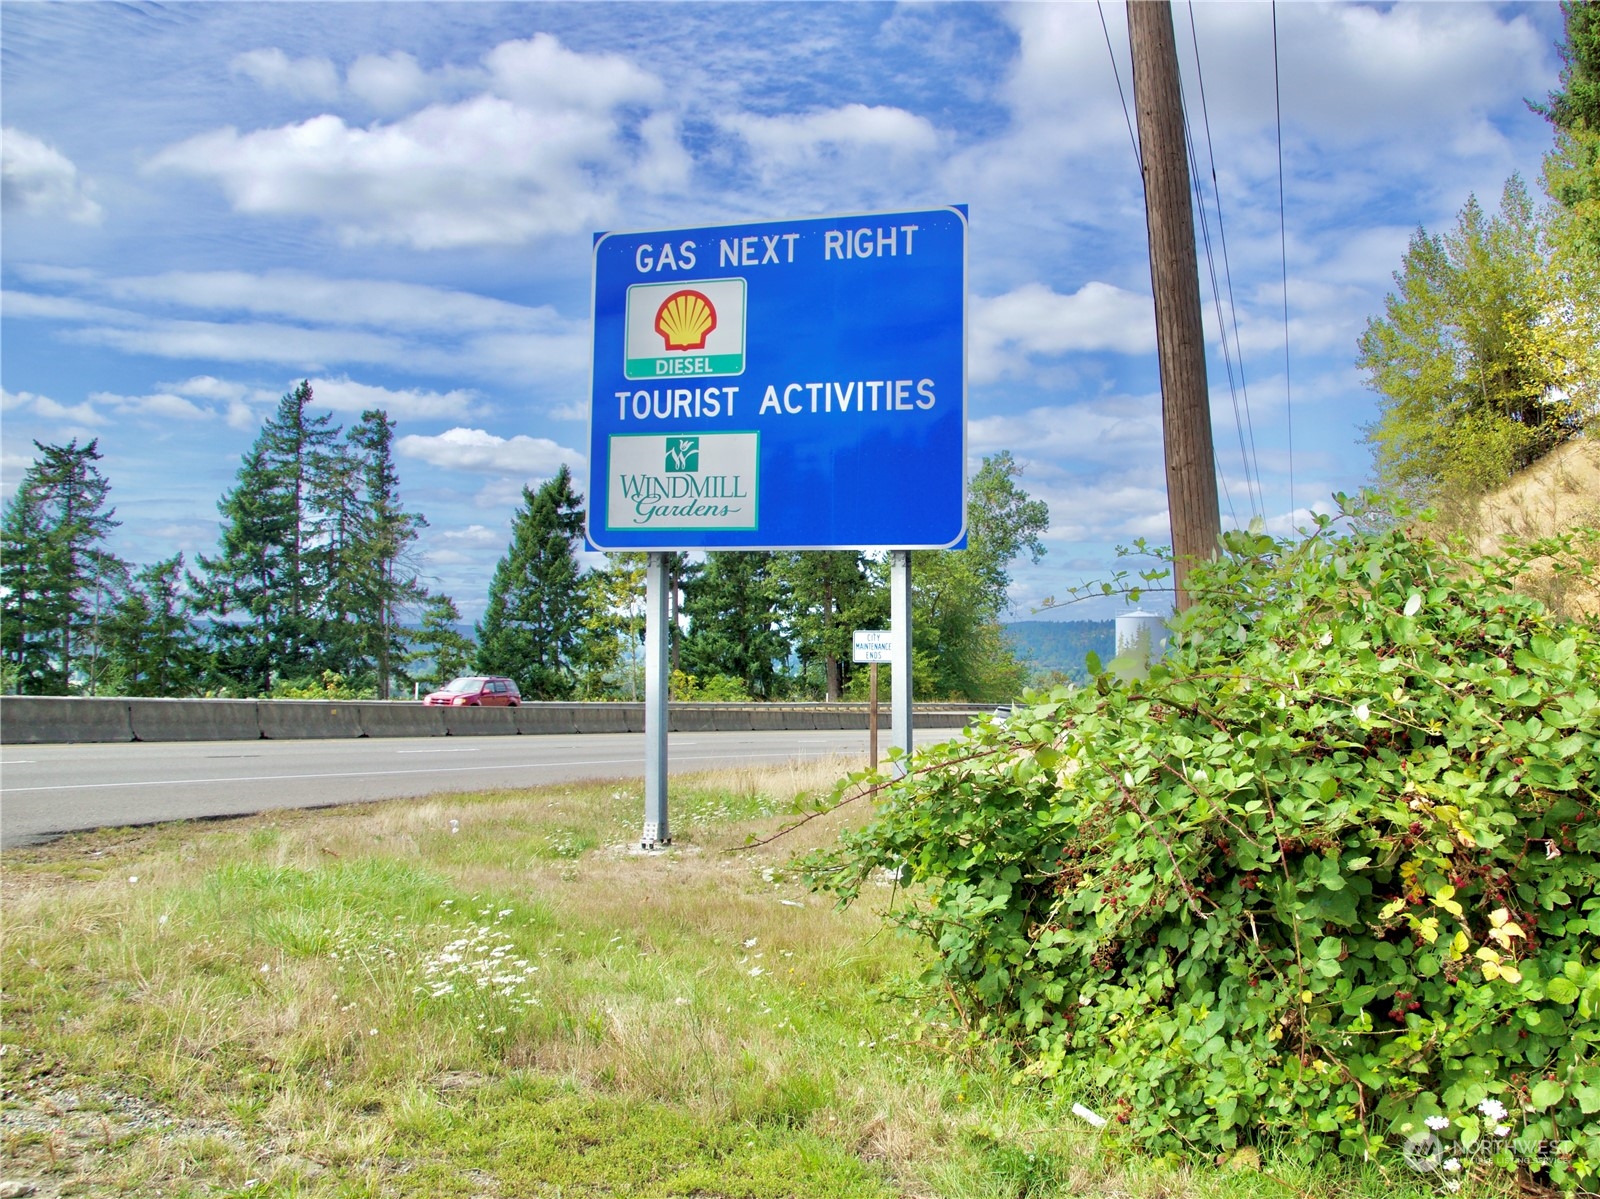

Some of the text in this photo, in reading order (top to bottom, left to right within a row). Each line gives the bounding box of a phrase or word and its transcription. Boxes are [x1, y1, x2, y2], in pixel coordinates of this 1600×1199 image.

[636, 225, 919, 273] GAS NEXT RIGHT
[655, 357, 713, 375] DIESEL
[615, 379, 936, 421] TOURIST ACTIVITIES
[620, 473, 747, 499] WINDMILL
[631, 493, 741, 524] Gardens
[855, 642, 892, 651] MAINTENANCE
[866, 633, 880, 642] CITY
[865, 651, 882, 660] ENDS
